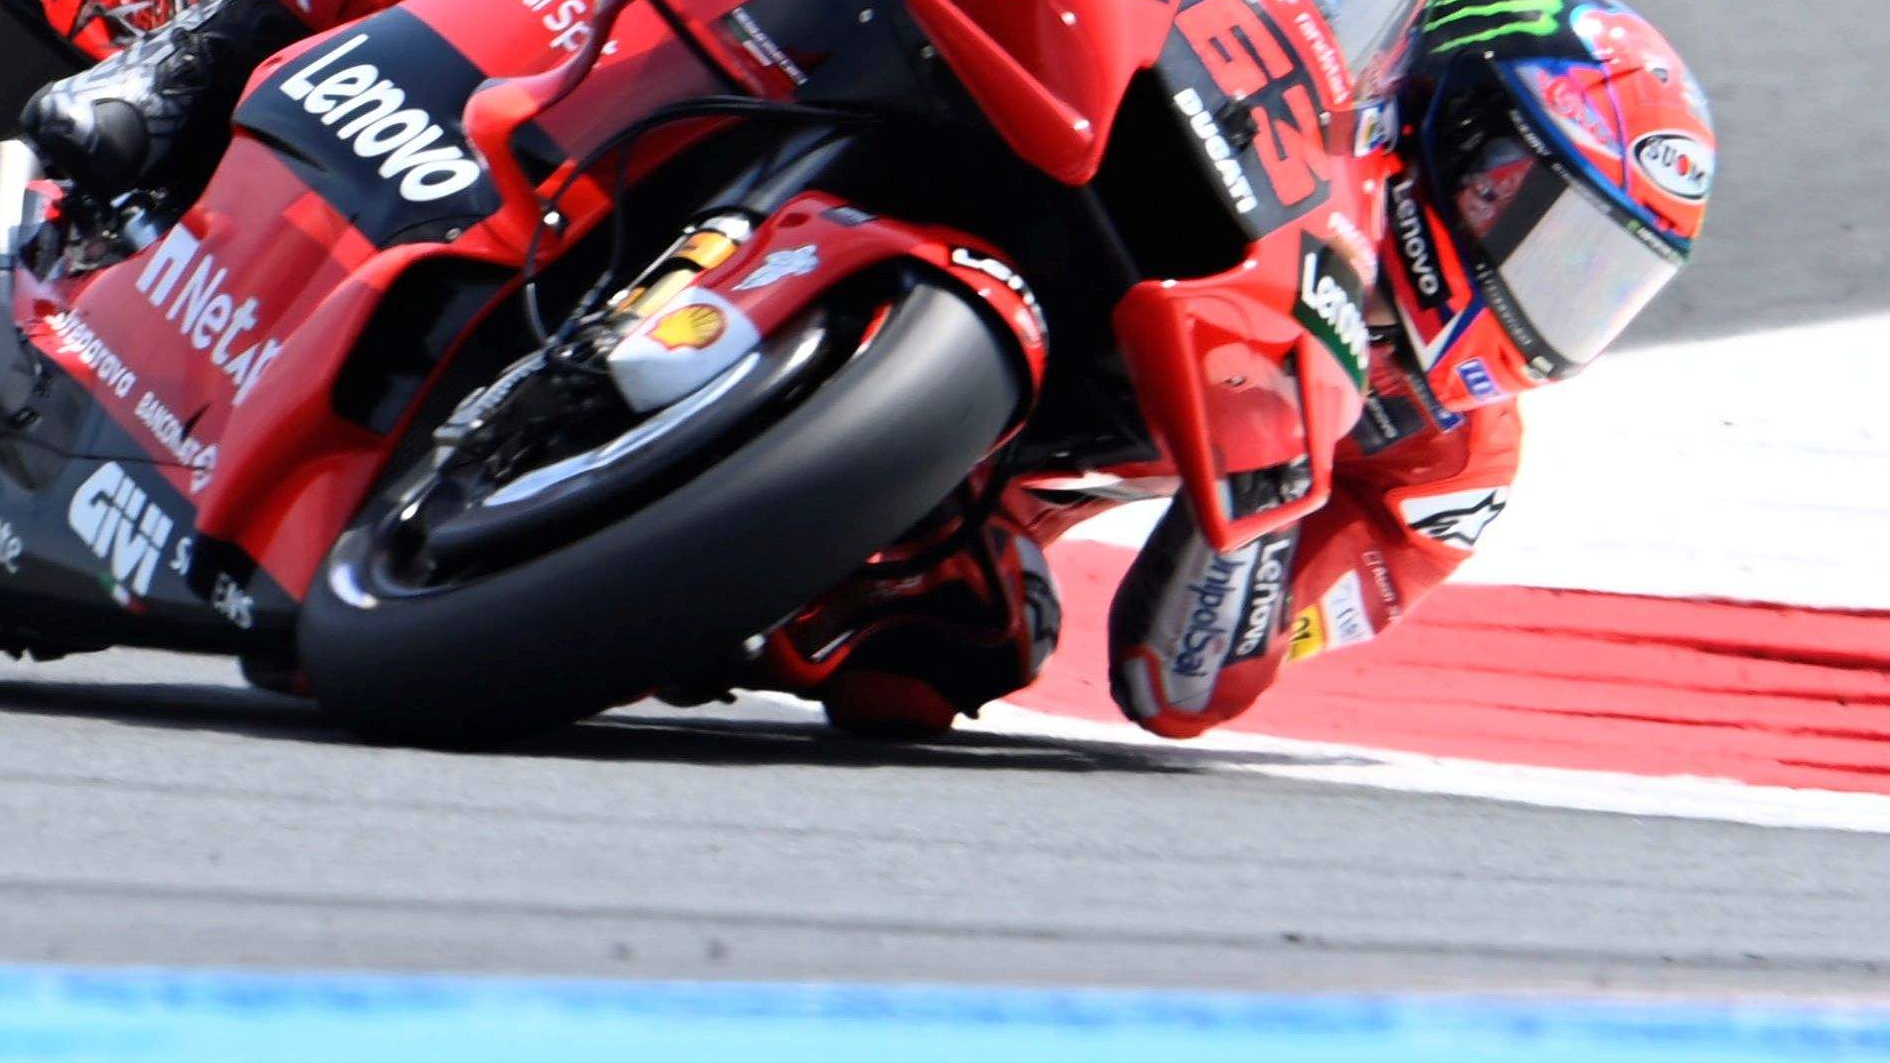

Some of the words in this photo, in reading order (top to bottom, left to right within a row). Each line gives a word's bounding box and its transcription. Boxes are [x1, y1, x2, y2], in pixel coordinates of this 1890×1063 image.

[278, 33, 481, 202] Lenovo
[1174, 87, 1258, 213] DUCATI
[1391, 177, 1439, 296] Lenovo
[67, 461, 175, 598] GIVI
[1235, 537, 1291, 658] Lenovo
